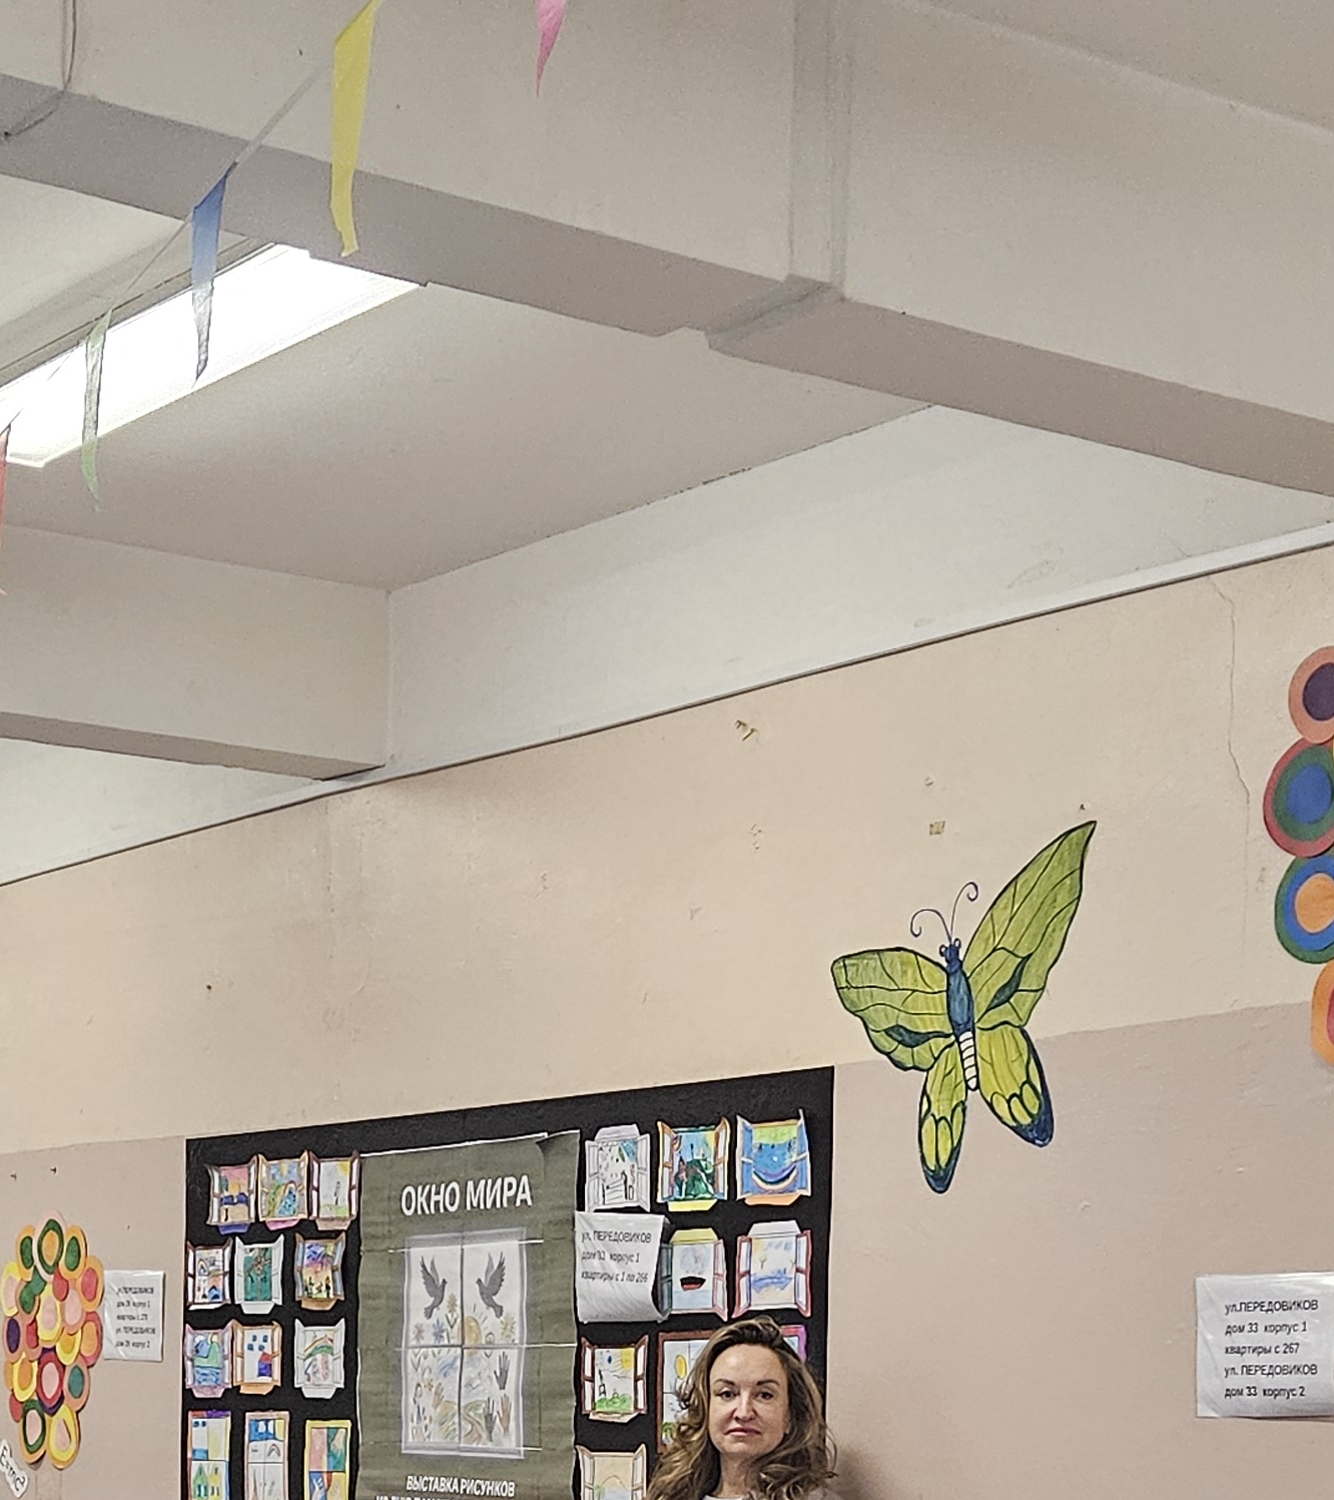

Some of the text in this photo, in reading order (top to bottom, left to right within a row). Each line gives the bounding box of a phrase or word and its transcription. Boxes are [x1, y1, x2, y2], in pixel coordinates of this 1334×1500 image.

[401, 1175, 533, 1216] ОКНО МИРА
[1225, 1321, 1307, 1337] дом 33 корпус 1
[1225, 1342, 1300, 1357] квартиры с 267
[1224, 1364, 1318, 1379] ул. ПЕРЕДОВИКОВ
[1224, 1386, 1306, 1400] дом 33 корпус 2
[406, 1475, 516, 1497] ВЫСТАВКА РИСУНКОВ
